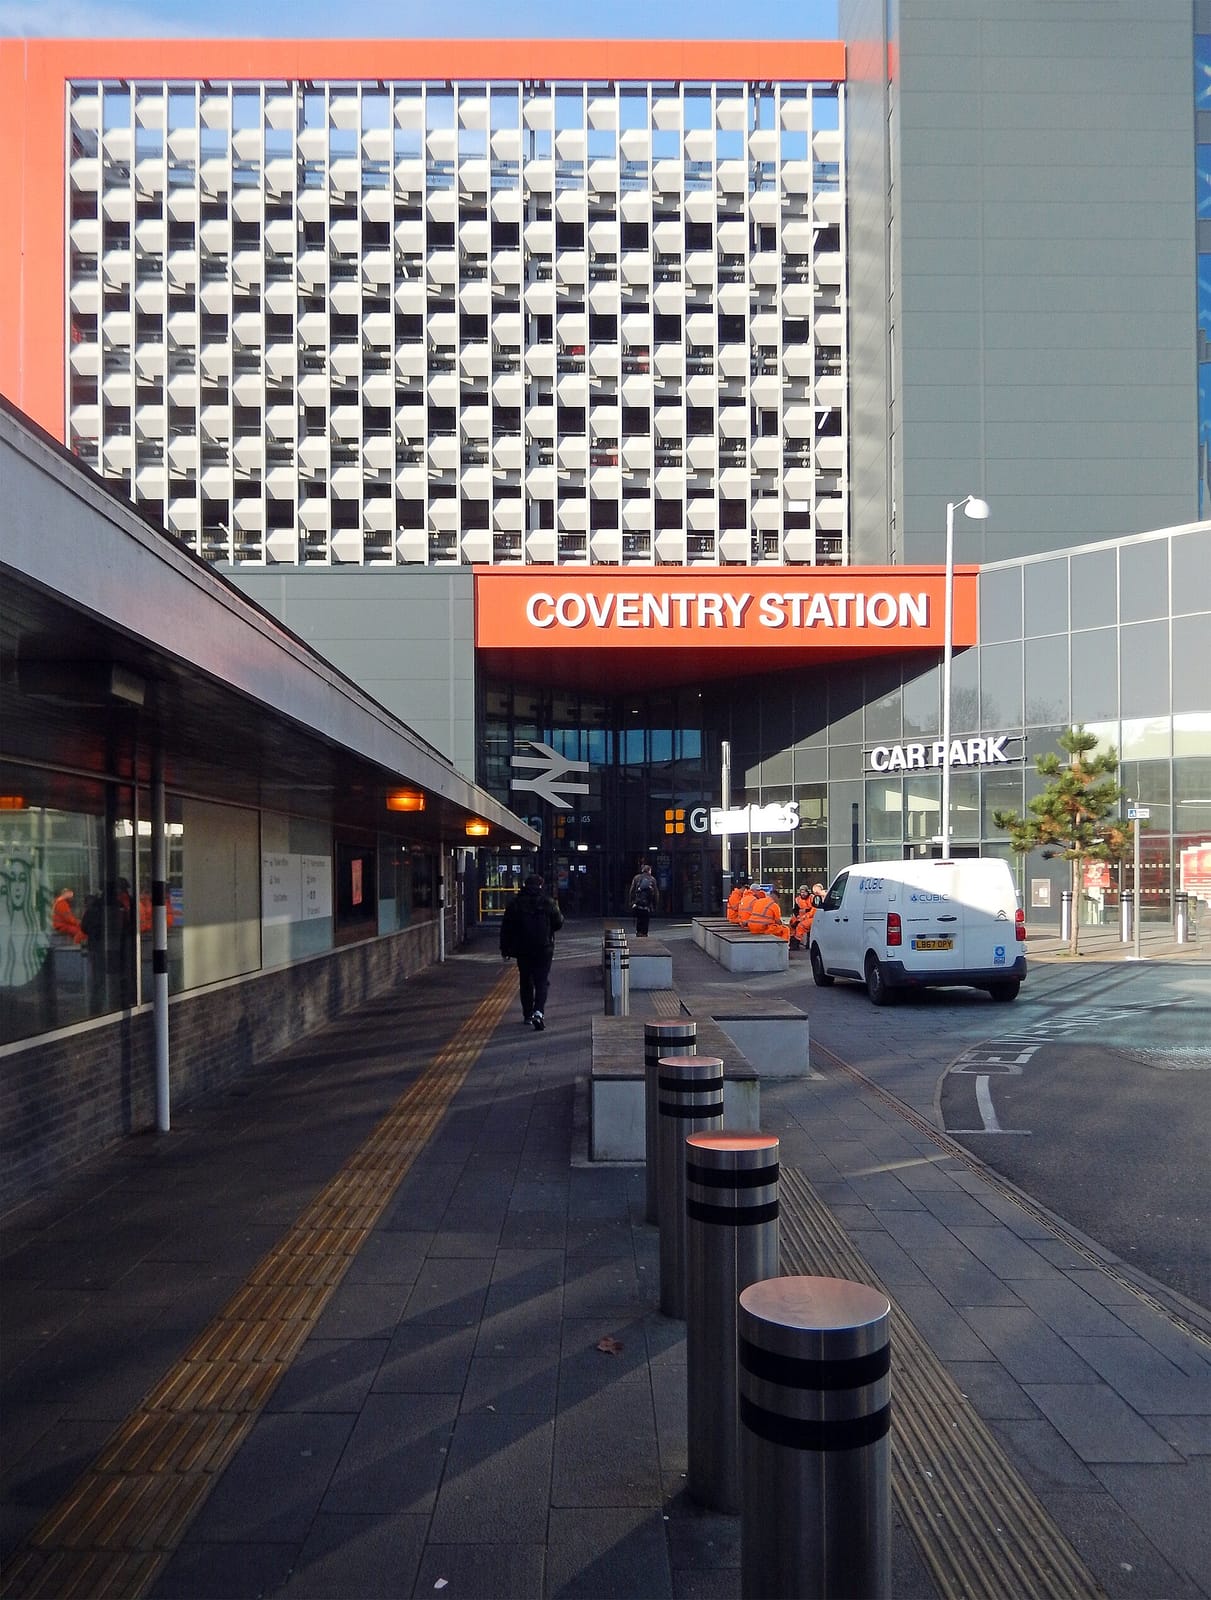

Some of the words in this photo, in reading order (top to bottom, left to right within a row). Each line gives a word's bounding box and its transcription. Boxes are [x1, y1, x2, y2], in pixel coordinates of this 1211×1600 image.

[525, 591, 753, 629] COVENTRY
[758, 591, 930, 629] STATION
[870, 743, 926, 772] CAR
[932, 735, 1008, 767] PARK
[919, 894, 949, 903] CUBIC
[916, 940, 936, 949] LB67
[949, 1007, 1152, 1075] DELIVERIES
